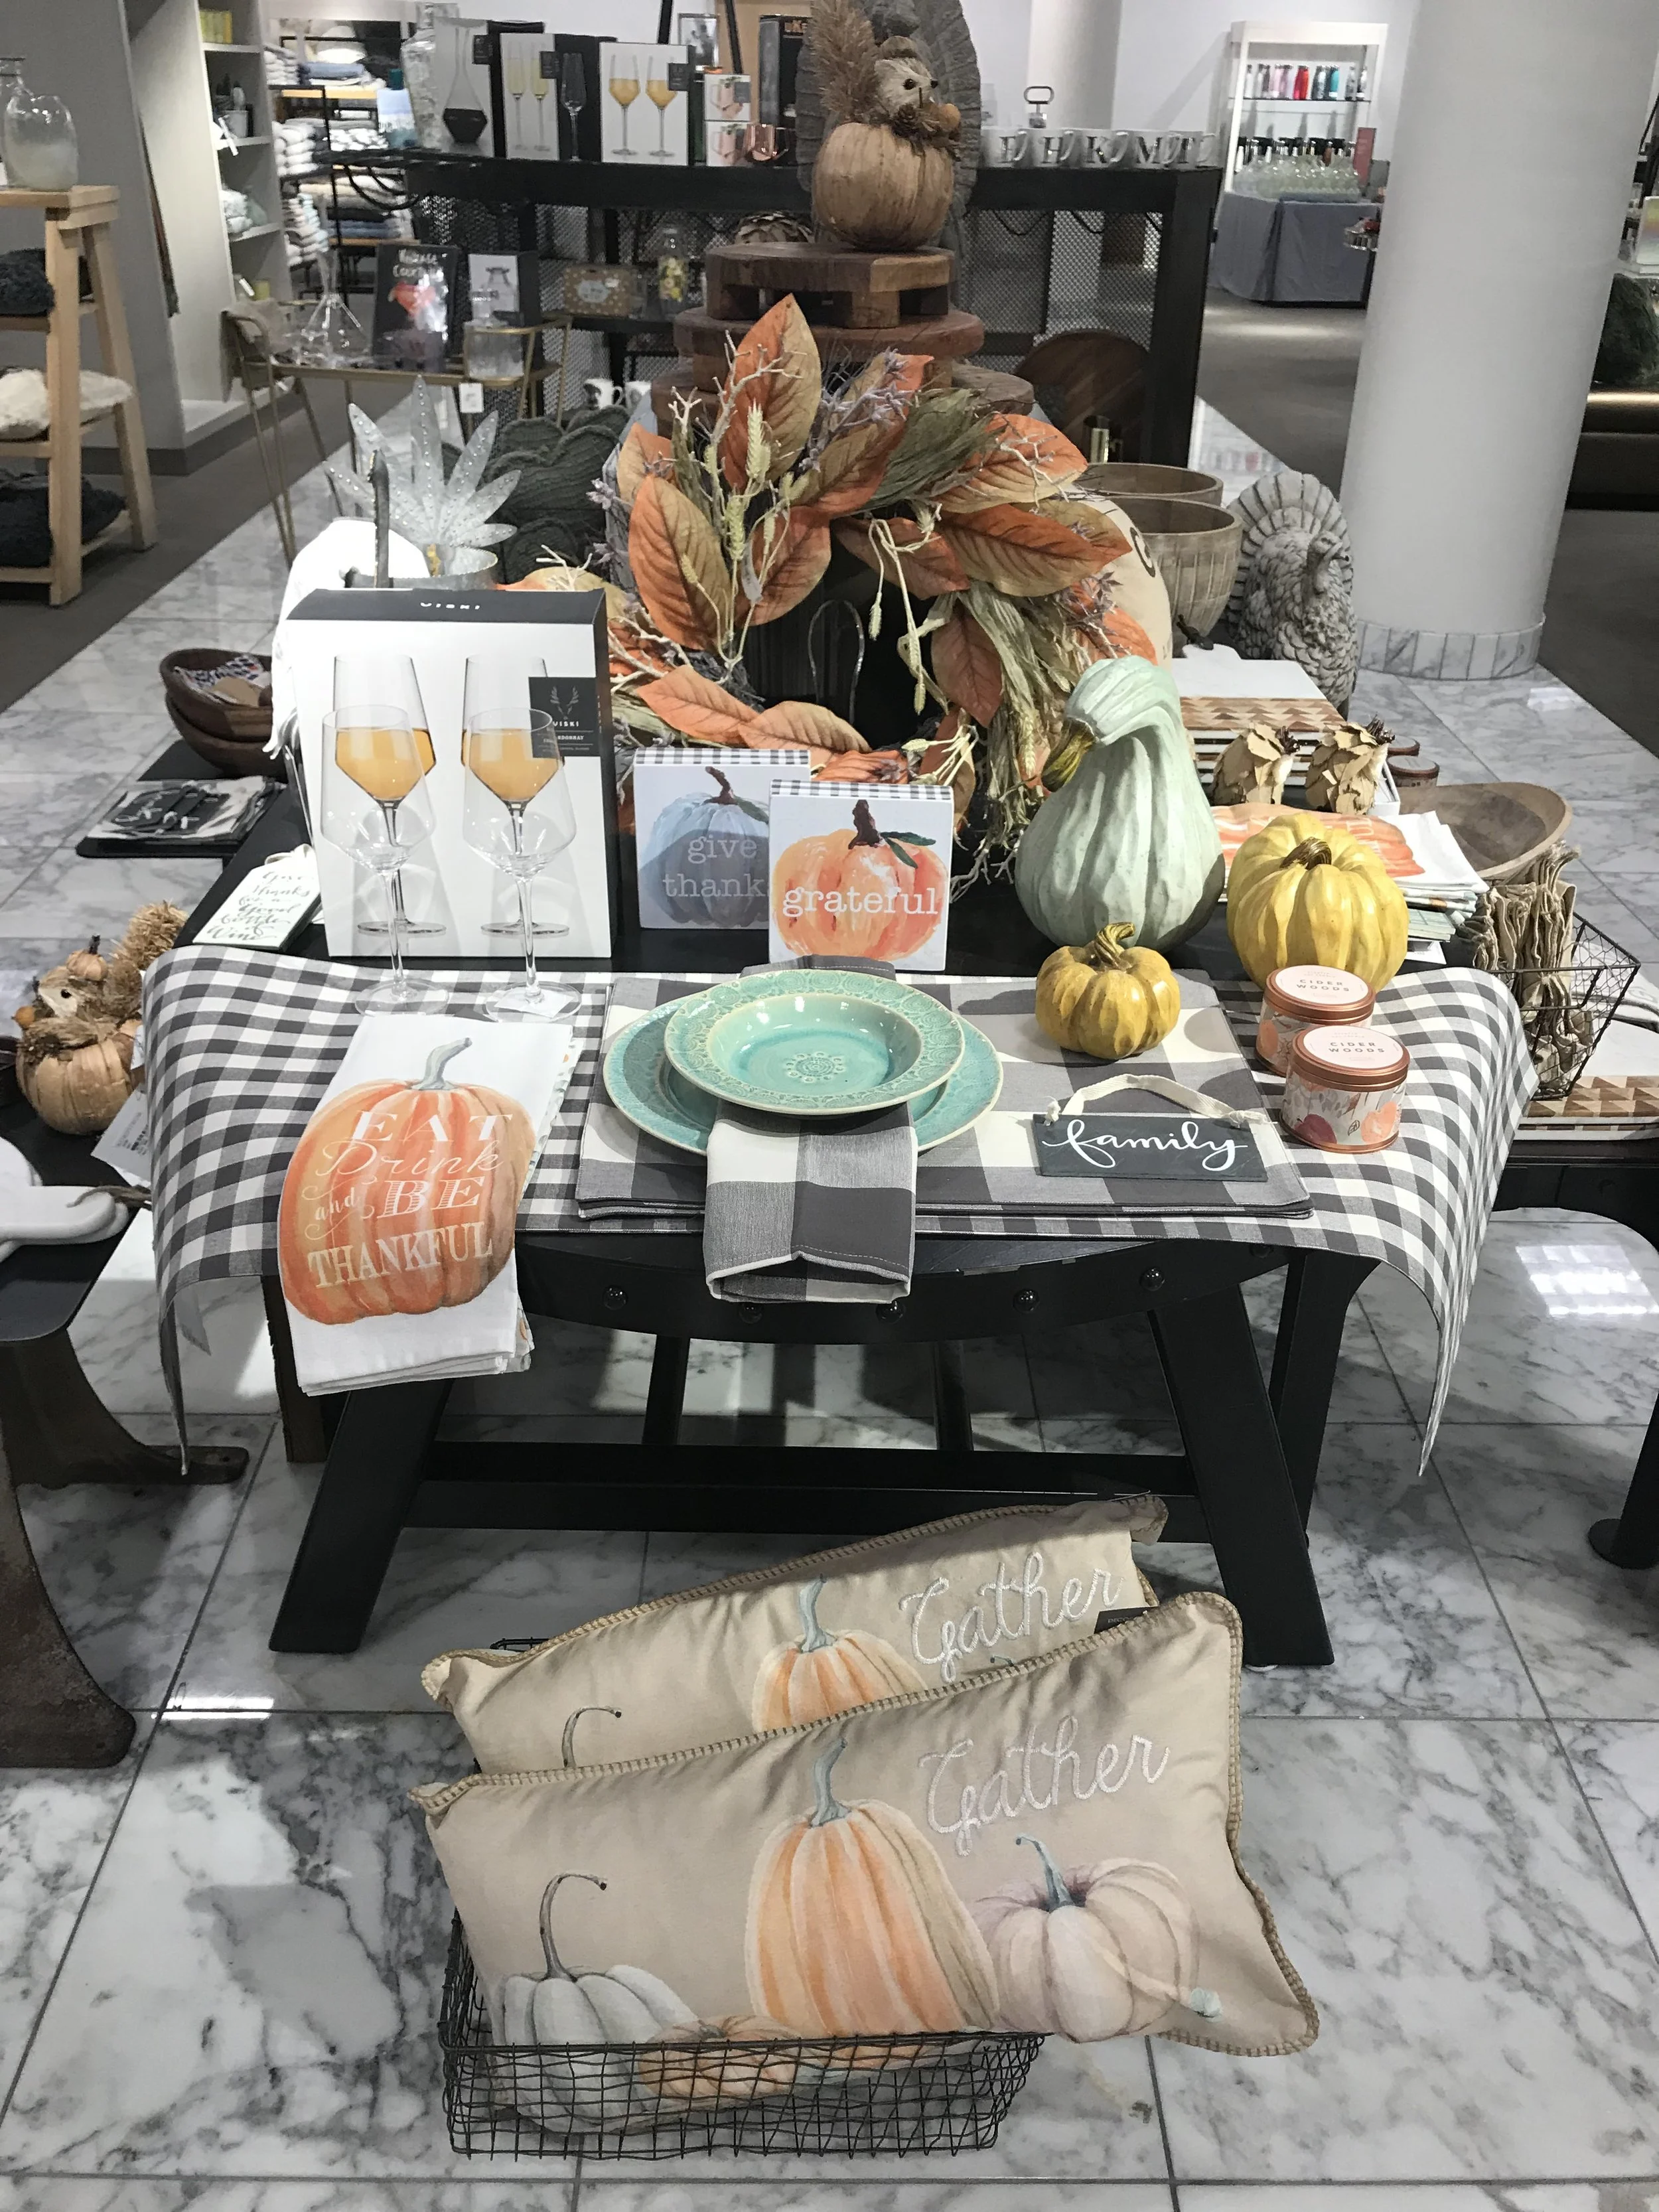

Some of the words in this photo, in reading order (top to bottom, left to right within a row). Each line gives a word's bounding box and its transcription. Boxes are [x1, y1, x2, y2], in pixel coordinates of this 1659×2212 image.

[687, 834, 758, 863] give
[662, 873, 768, 897] thank
[782, 885, 939, 919] grateful
[350, 1111, 513, 1142] EAT
[1041, 1119, 1248, 1171] family
[315, 1140, 504, 1177] Drink
[314, 1187, 360, 1221] and
[377, 1176, 485, 1220] BE
[307, 1221, 493, 1289] THANKFUL
[899, 1552, 1125, 1684] Gather
[918, 1715, 1172, 1857] Gather
